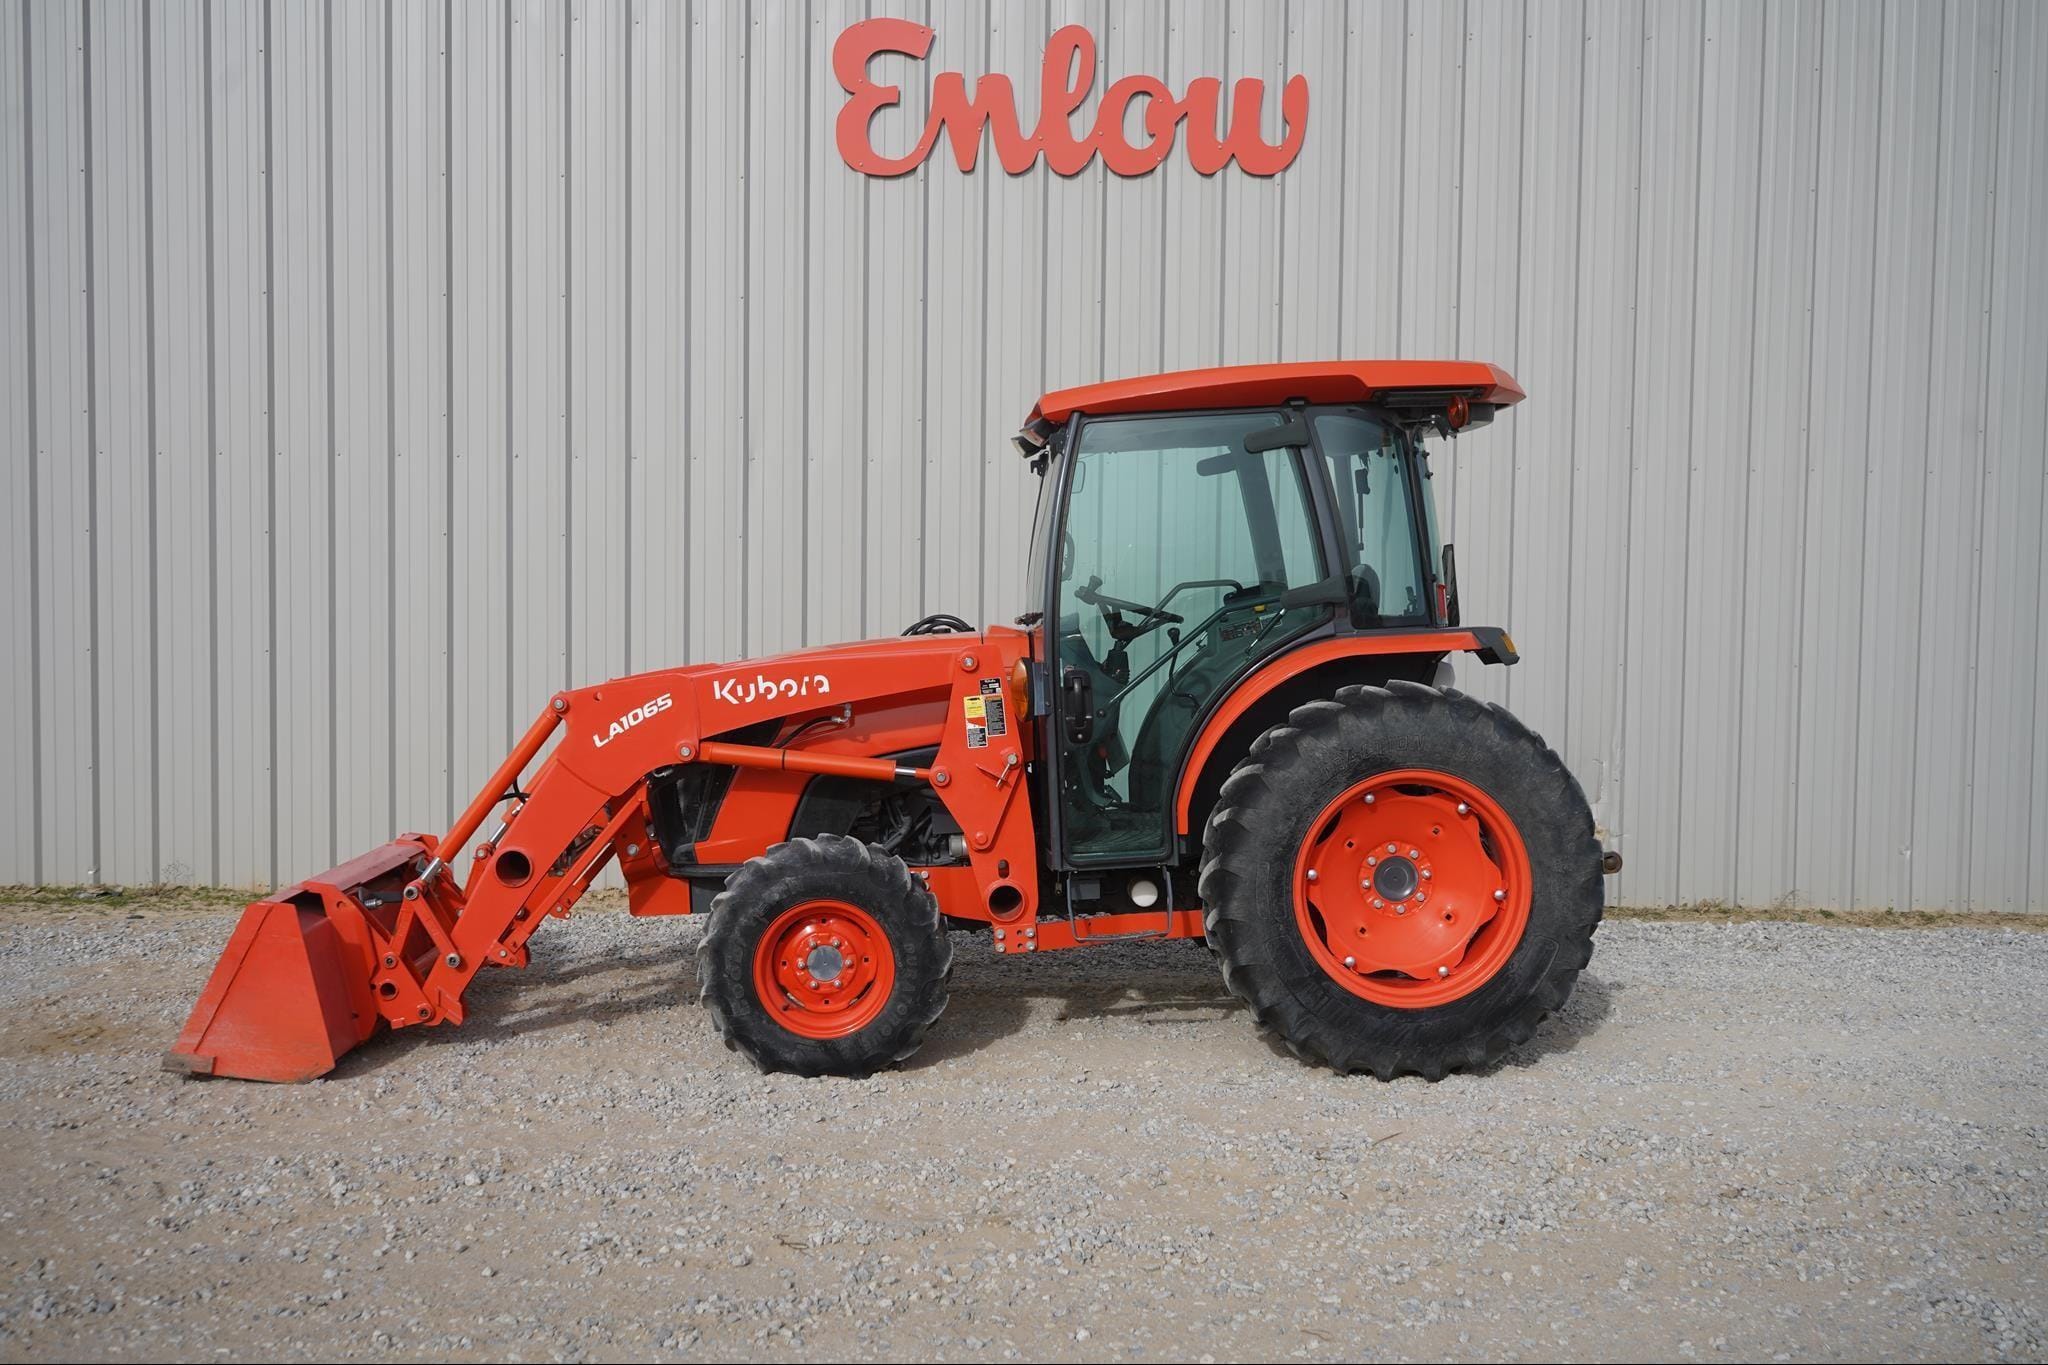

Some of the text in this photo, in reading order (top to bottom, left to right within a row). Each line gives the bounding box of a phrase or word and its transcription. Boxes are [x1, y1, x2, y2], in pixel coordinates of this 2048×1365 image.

[832, 17, 1309, 176] Enlow
[713, 675, 830, 704] Kubota
[593, 693, 672, 748] LA1065
